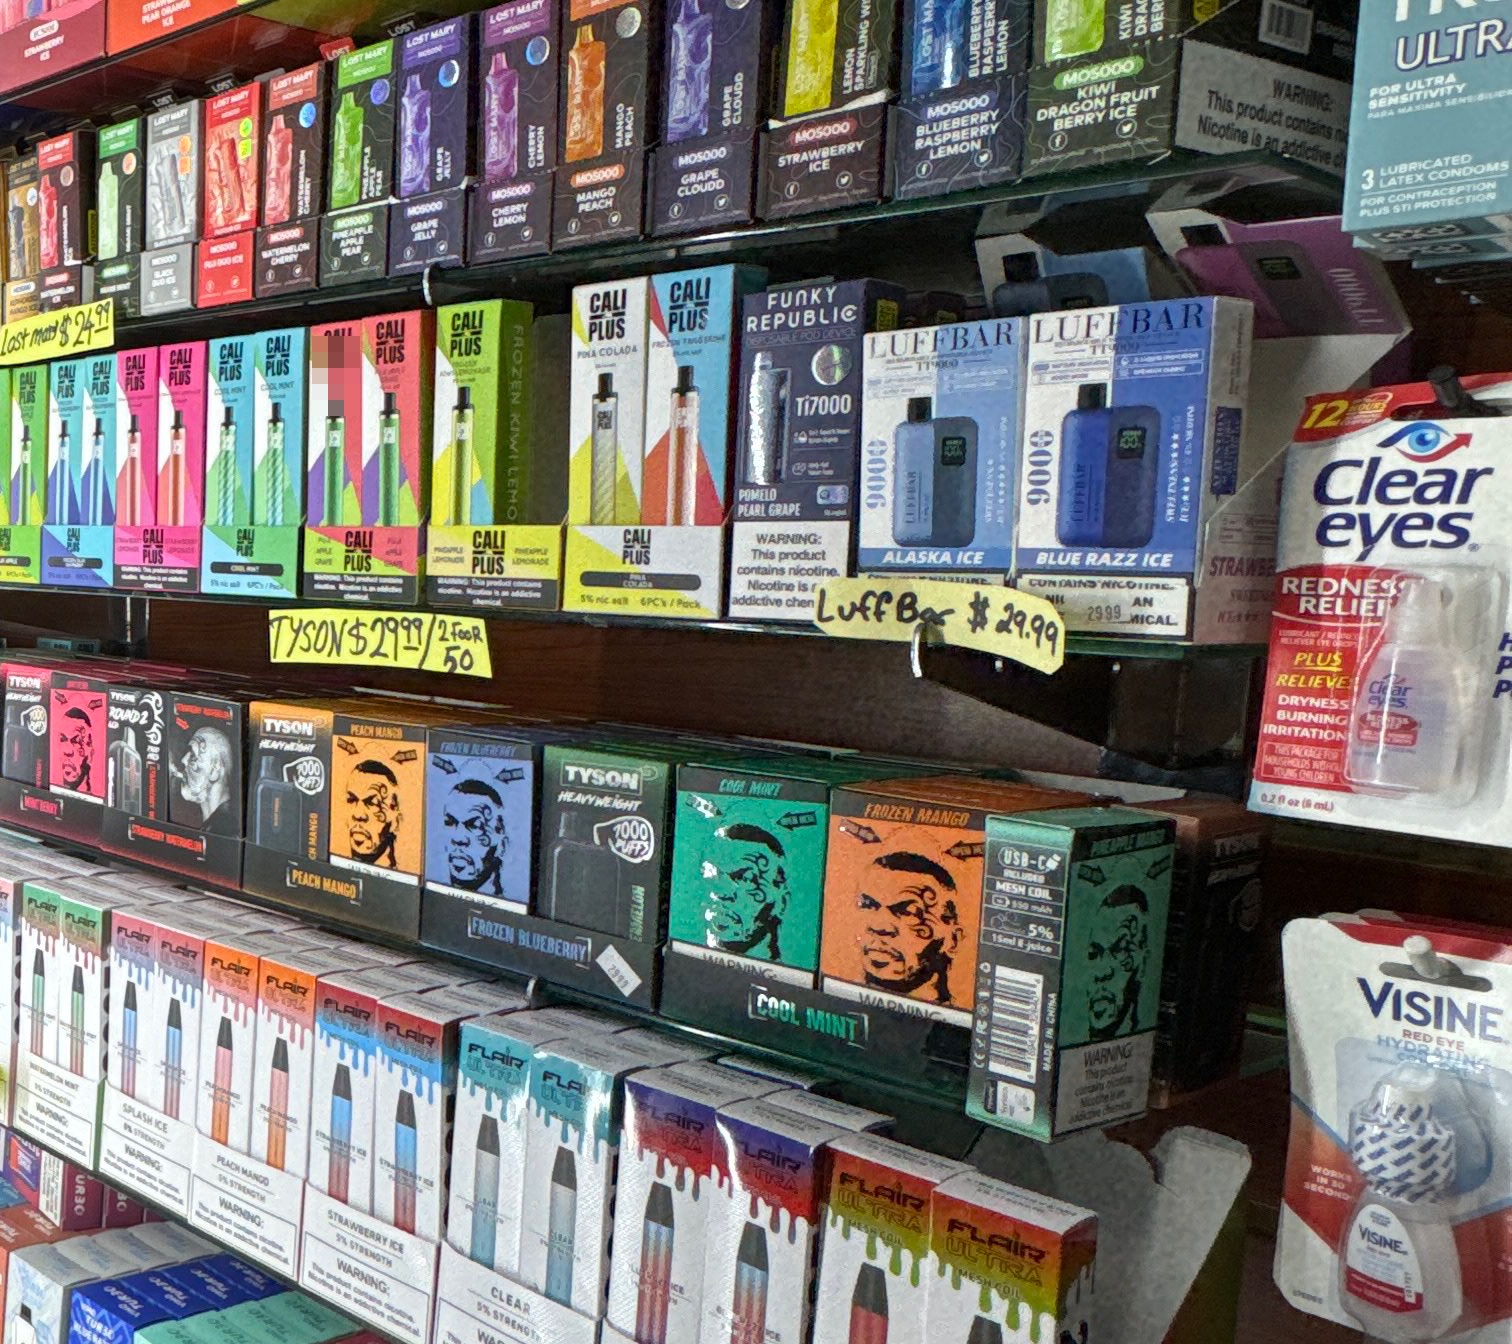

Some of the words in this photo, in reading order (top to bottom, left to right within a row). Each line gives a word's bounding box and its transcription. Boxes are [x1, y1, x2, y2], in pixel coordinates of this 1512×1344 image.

[1077, 80, 1117, 100] KIWI
[1272, 79, 1335, 113] WARNING:
[1369, 83, 1467, 110] SENSITIVITY
[1370, 83, 1401, 98] FOR
[1406, 73, 1457, 91] ULTRA
[1036, 96, 1106, 120] DRAGON
[1110, 85, 1160, 111] FRUIT
[1207, 88, 1234, 114] This
[1236, 99, 1283, 128] product
[1285, 110, 1332, 139] contains
[915, 108, 999, 137] BLUEBERRY
[1053, 109, 1103, 131] BERRY
[1107, 102, 1137, 121] ICE
[914, 121, 999, 149] RASPBERRY
[777, 140, 865, 168] STRAWBERRY
[929, 139, 982, 160] LEMON
[808, 156, 831, 173] ICE
[1379, 171, 1423, 188] LATEX
[1428, 160, 1510, 182] CONDOMS
[1380, 153, 1472, 177] LUBRICATED
[1362, 169, 1374, 190] 3
[576, 187, 616, 203] MANGO
[578, 198, 613, 213] PEACH
[492, 203, 528, 218] CHERRY
[493, 213, 526, 228] LEMON
[589, 288, 627, 313] CALI
[588, 315, 625, 343] PLUS
[746, 304, 858, 333] REPUBLIC
[1033, 303, 1205, 345] LUFFBAR
[868, 320, 1013, 360] LUFFBAR
[795, 394, 852, 418] Ti7000
[1301, 398, 1348, 430] 12
[1027, 429, 1053, 507] 9000
[1313, 457, 1494, 507] Clear
[738, 488, 777, 503] POMELO
[738, 503, 766, 518] PEARL
[768, 502, 801, 518] GRAPE
[756, 532, 823, 546] WARNING:
[1315, 510, 1474, 562] eyes
[881, 549, 952, 566] ALASKA
[955, 551, 985, 566] ICE
[1035, 552, 1081, 568] BLUE
[1085, 552, 1139, 569] RAZZ
[1142, 552, 1173, 569] ICE
[269, 616, 347, 659] TYSON
[1293, 651, 1343, 670] PLUS
[1278, 693, 1349, 710] DRYNESS
[1275, 709, 1348, 727] BURNING
[1263, 723, 1347, 741] IRRITATION
[564, 765, 638, 790] TYSON
[864, 803, 914, 823] FROZEN
[918, 807, 972, 828] MANGO
[995, 881, 1024, 897] MESH
[1026, 885, 1053, 902] COIL
[472, 917, 515, 943] FROZEN
[518, 929, 588, 962] BLUEBERRY
[1027, 923, 1054, 940] 5%
[755, 990, 800, 1022] COOL
[805, 1007, 859, 1042] MINT
[1356, 976, 1504, 1043] VISINE
[490, 1285, 531, 1316] CLEAR
